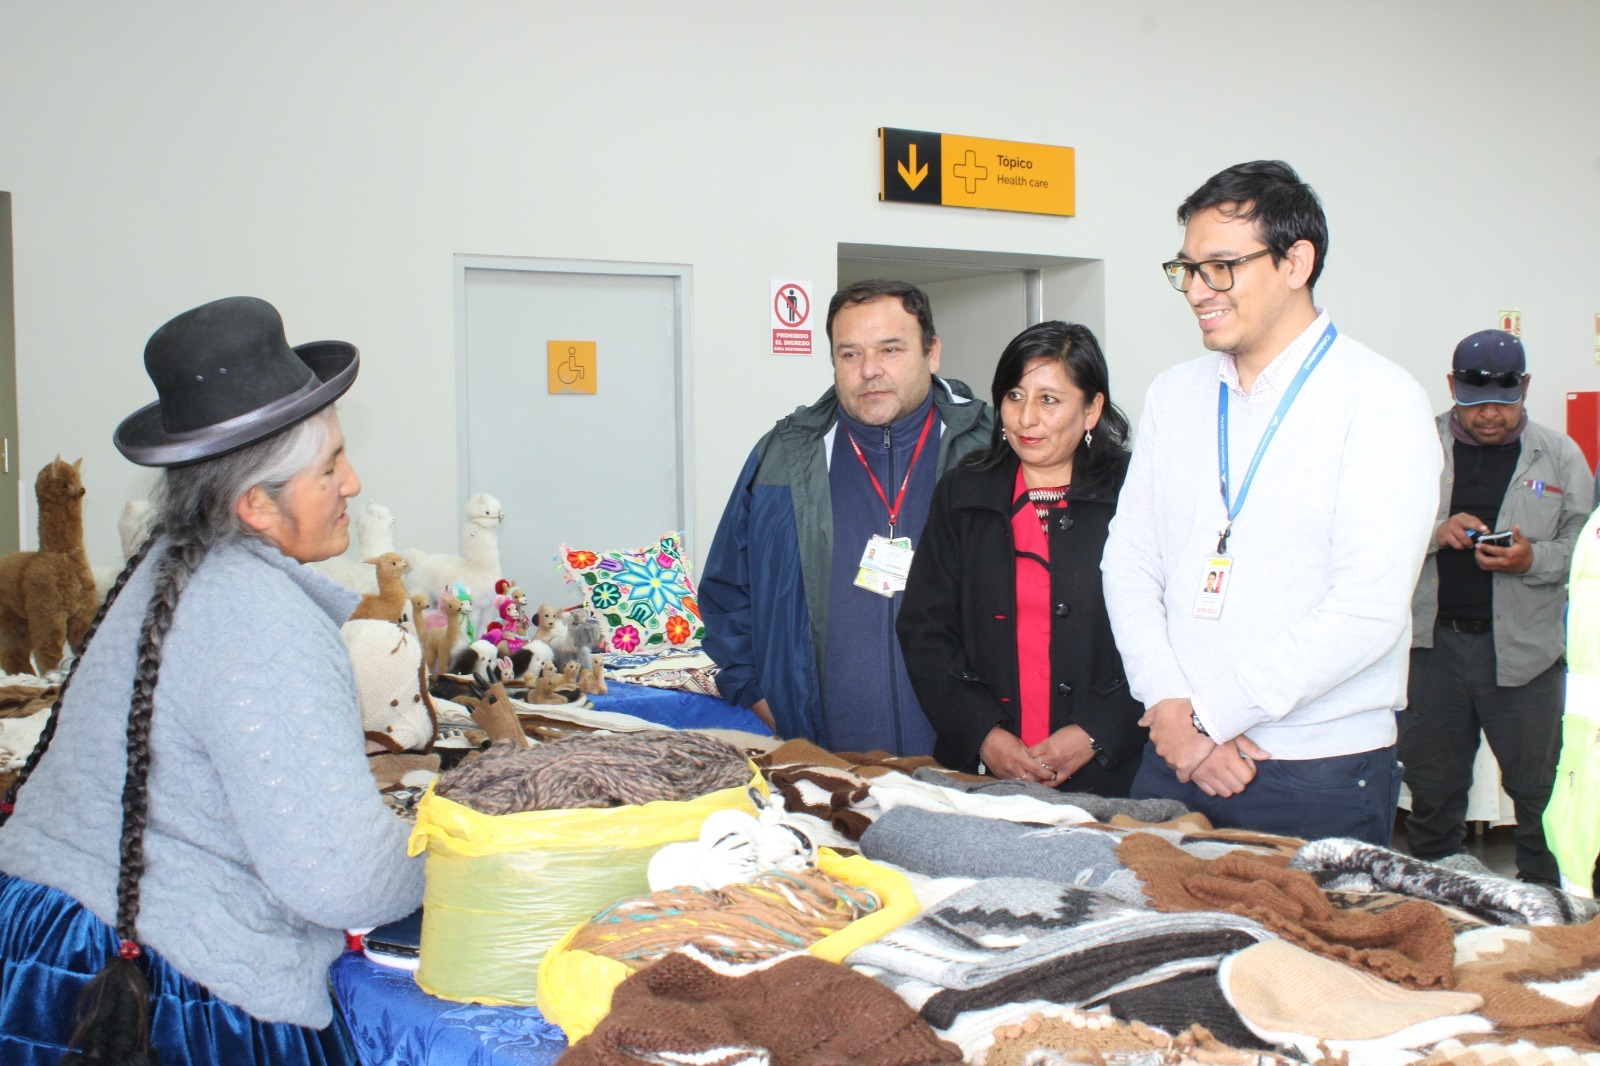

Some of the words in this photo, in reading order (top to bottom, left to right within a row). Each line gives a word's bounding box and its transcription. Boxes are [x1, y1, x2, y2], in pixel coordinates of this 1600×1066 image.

[997, 154, 1033, 170] Tópico
[997, 174, 1027, 186] Health
[1029, 179, 1048, 188] care
